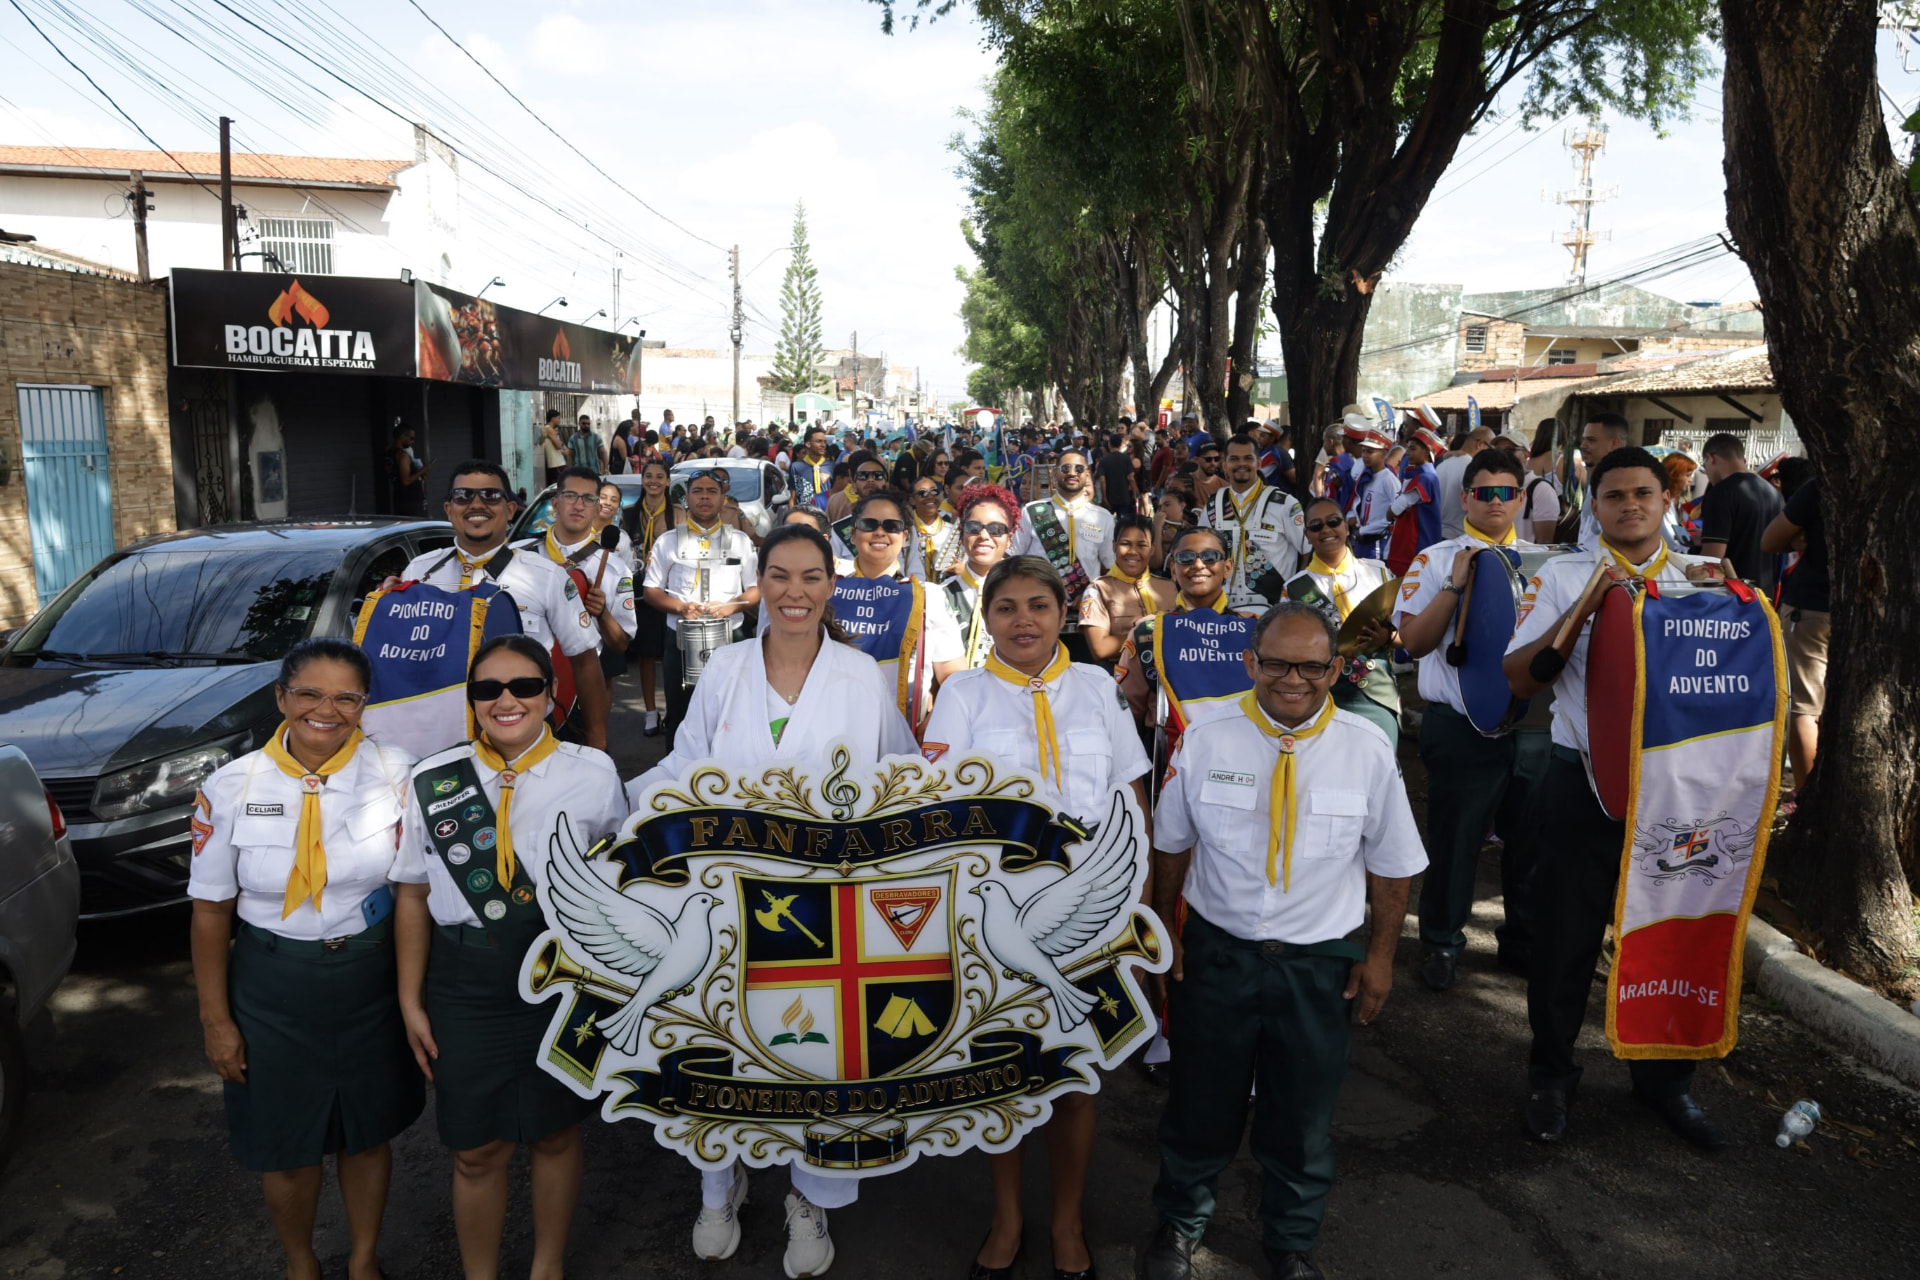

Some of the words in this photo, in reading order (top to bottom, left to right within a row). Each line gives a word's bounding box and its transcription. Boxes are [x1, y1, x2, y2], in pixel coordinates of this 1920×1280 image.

[224, 324, 376, 361] BOCATTA
[228, 354, 312, 367] HAMBURGUERIA
[313, 358, 320, 367] E
[321, 359, 375, 369] ESPETARIA
[538, 357, 582, 383] BOCATTA
[834, 585, 900, 601] PIONEIROS
[388, 601, 459, 620] PIONEIRO
[856, 605, 874, 618] DO
[410, 624, 430, 641] DO
[834, 618, 891, 635] DVENT
[1175, 618, 1247, 635] PIONEIROS
[1664, 619, 1751, 640] PIONEIROS
[379, 643, 446, 662] ADVENTO
[1201, 637, 1219, 649] DO
[1179, 648, 1244, 662] ADVENTO
[1695, 648, 1717, 667] DO
[1669, 675, 1750, 694] ADVENTO
[689, 806, 997, 859] FANFARRA
[875, 890, 937, 899] DESBRAVADORES
[1619, 978, 1719, 1006] ARACAJU-SE
[687, 1082, 840, 1113] PIONEIROS
[847, 1088, 887, 1112] DO
[896, 1063, 1023, 1109] ADVENTO
